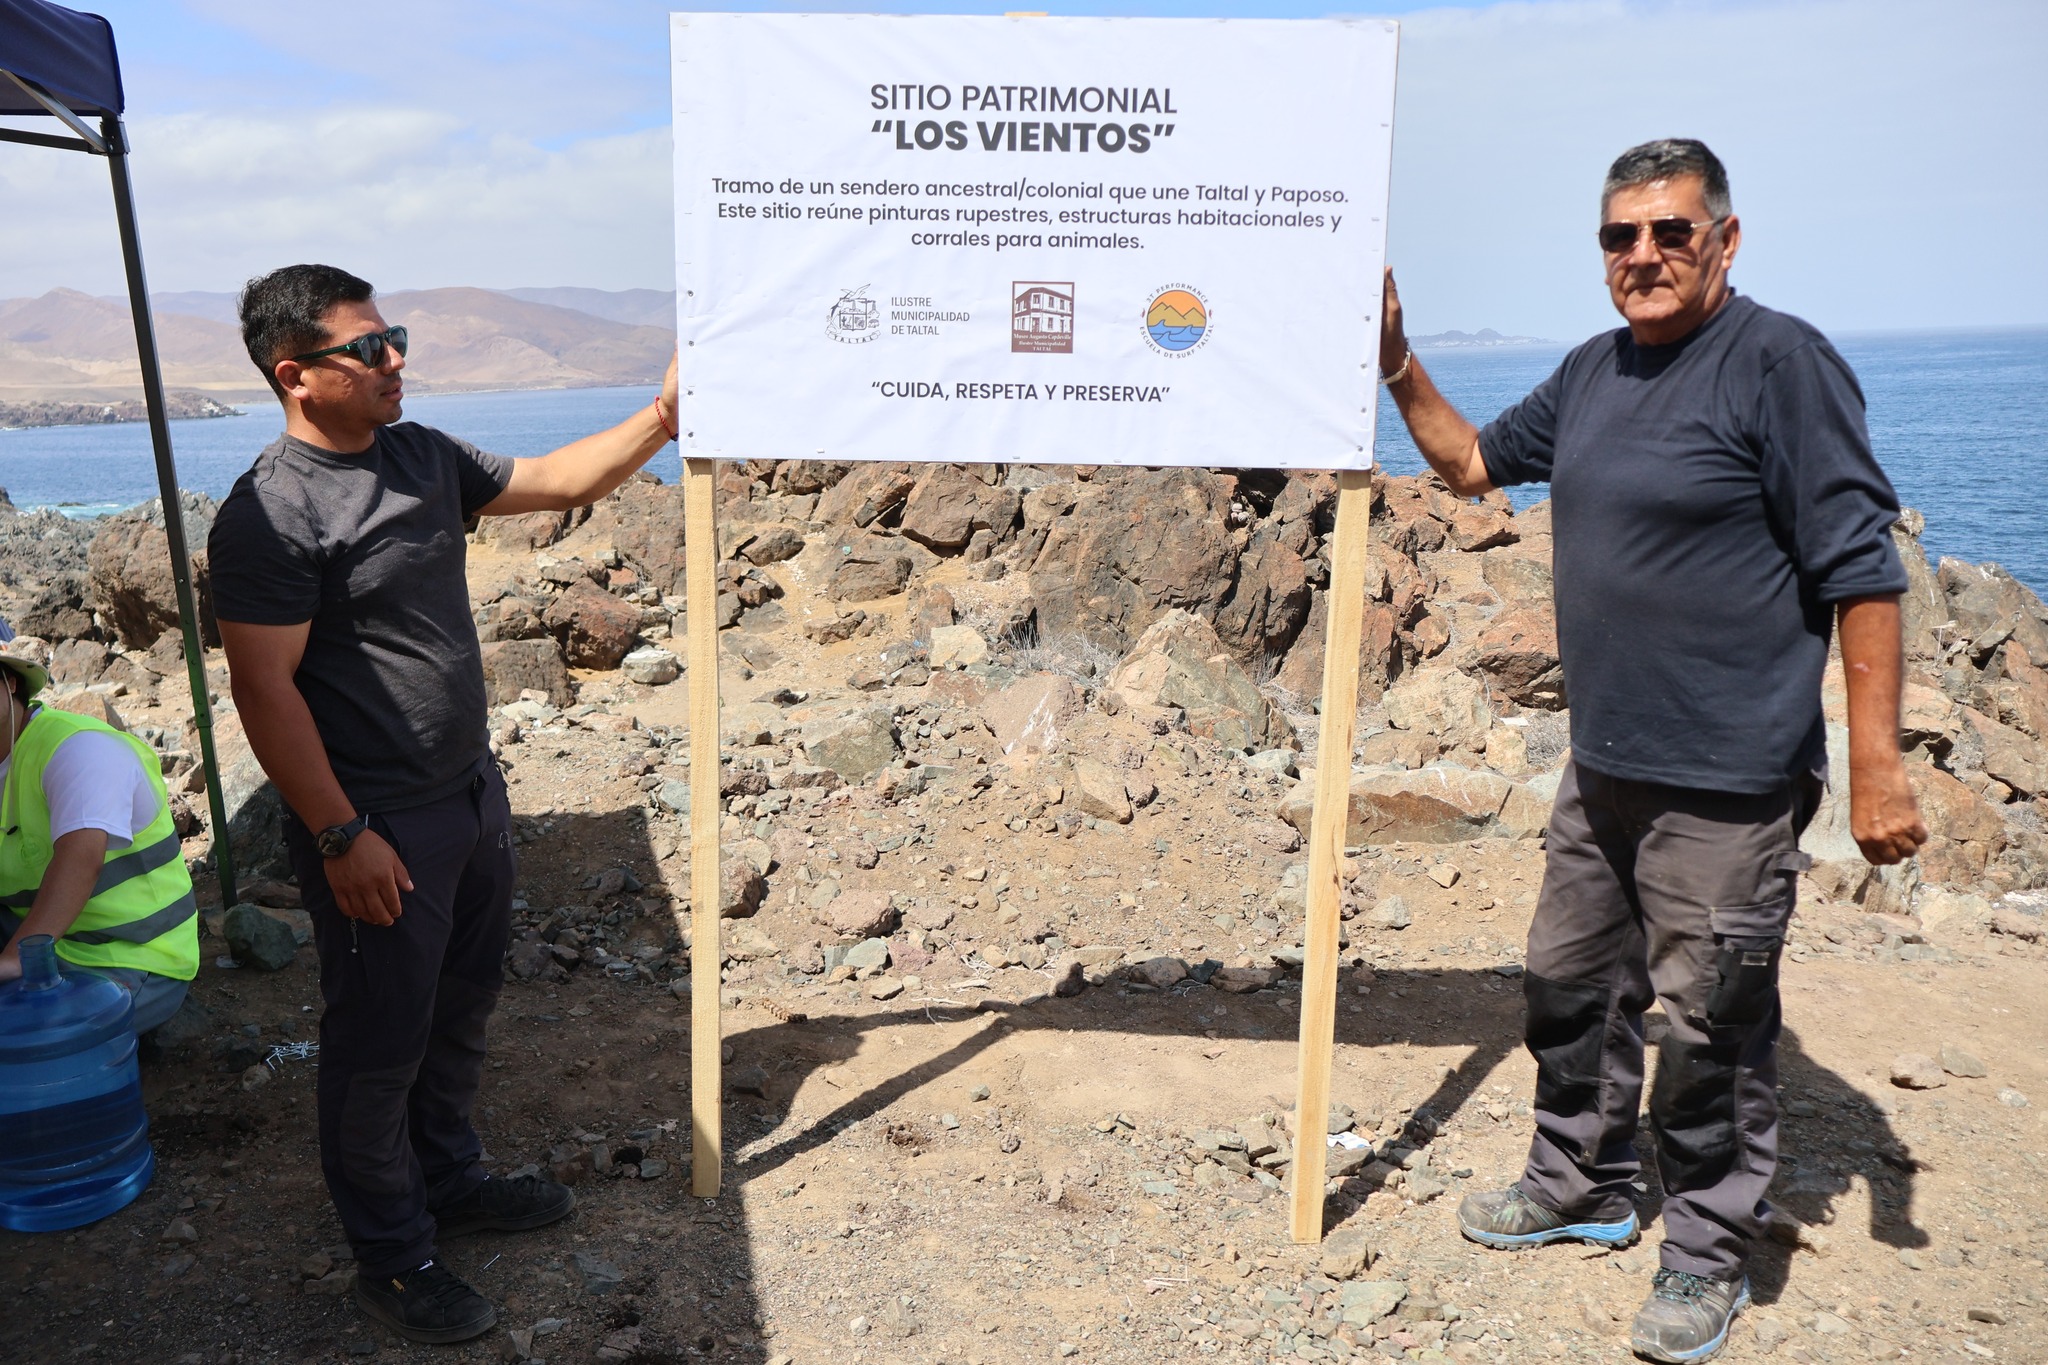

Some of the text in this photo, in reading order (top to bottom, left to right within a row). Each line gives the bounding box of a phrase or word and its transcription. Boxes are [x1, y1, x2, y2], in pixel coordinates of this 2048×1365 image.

[870, 83, 1178, 114] SITIO PATRIMONIAL
[871, 119, 1176, 154] “LOS VIENTOS”
[711, 177, 1349, 208] Tramo de un sendero ancestral/colonial que une Taltal y Paposo.
[718, 201, 1342, 233] Este sitio reúne pinturas rupestres, estructuras habitacionales y
[911, 230, 1145, 252] corrales para animales.
[891, 296, 932, 307] ILUSTRE
[1146, 282, 1209, 304] 3T PERFORMANCE
[891, 310, 971, 322] MUNICIPALIDAD
[834, 334, 873, 344] TALTAL
[891, 324, 940, 336] DE TALTAL
[1140, 326, 1161, 354] ESCUELA
[1176, 349, 1195, 359] SURF
[1196, 324, 1214, 350] TALTAL
[871, 381, 1171, 403] “CUIDA, RESPETA Y PRESERVA”
